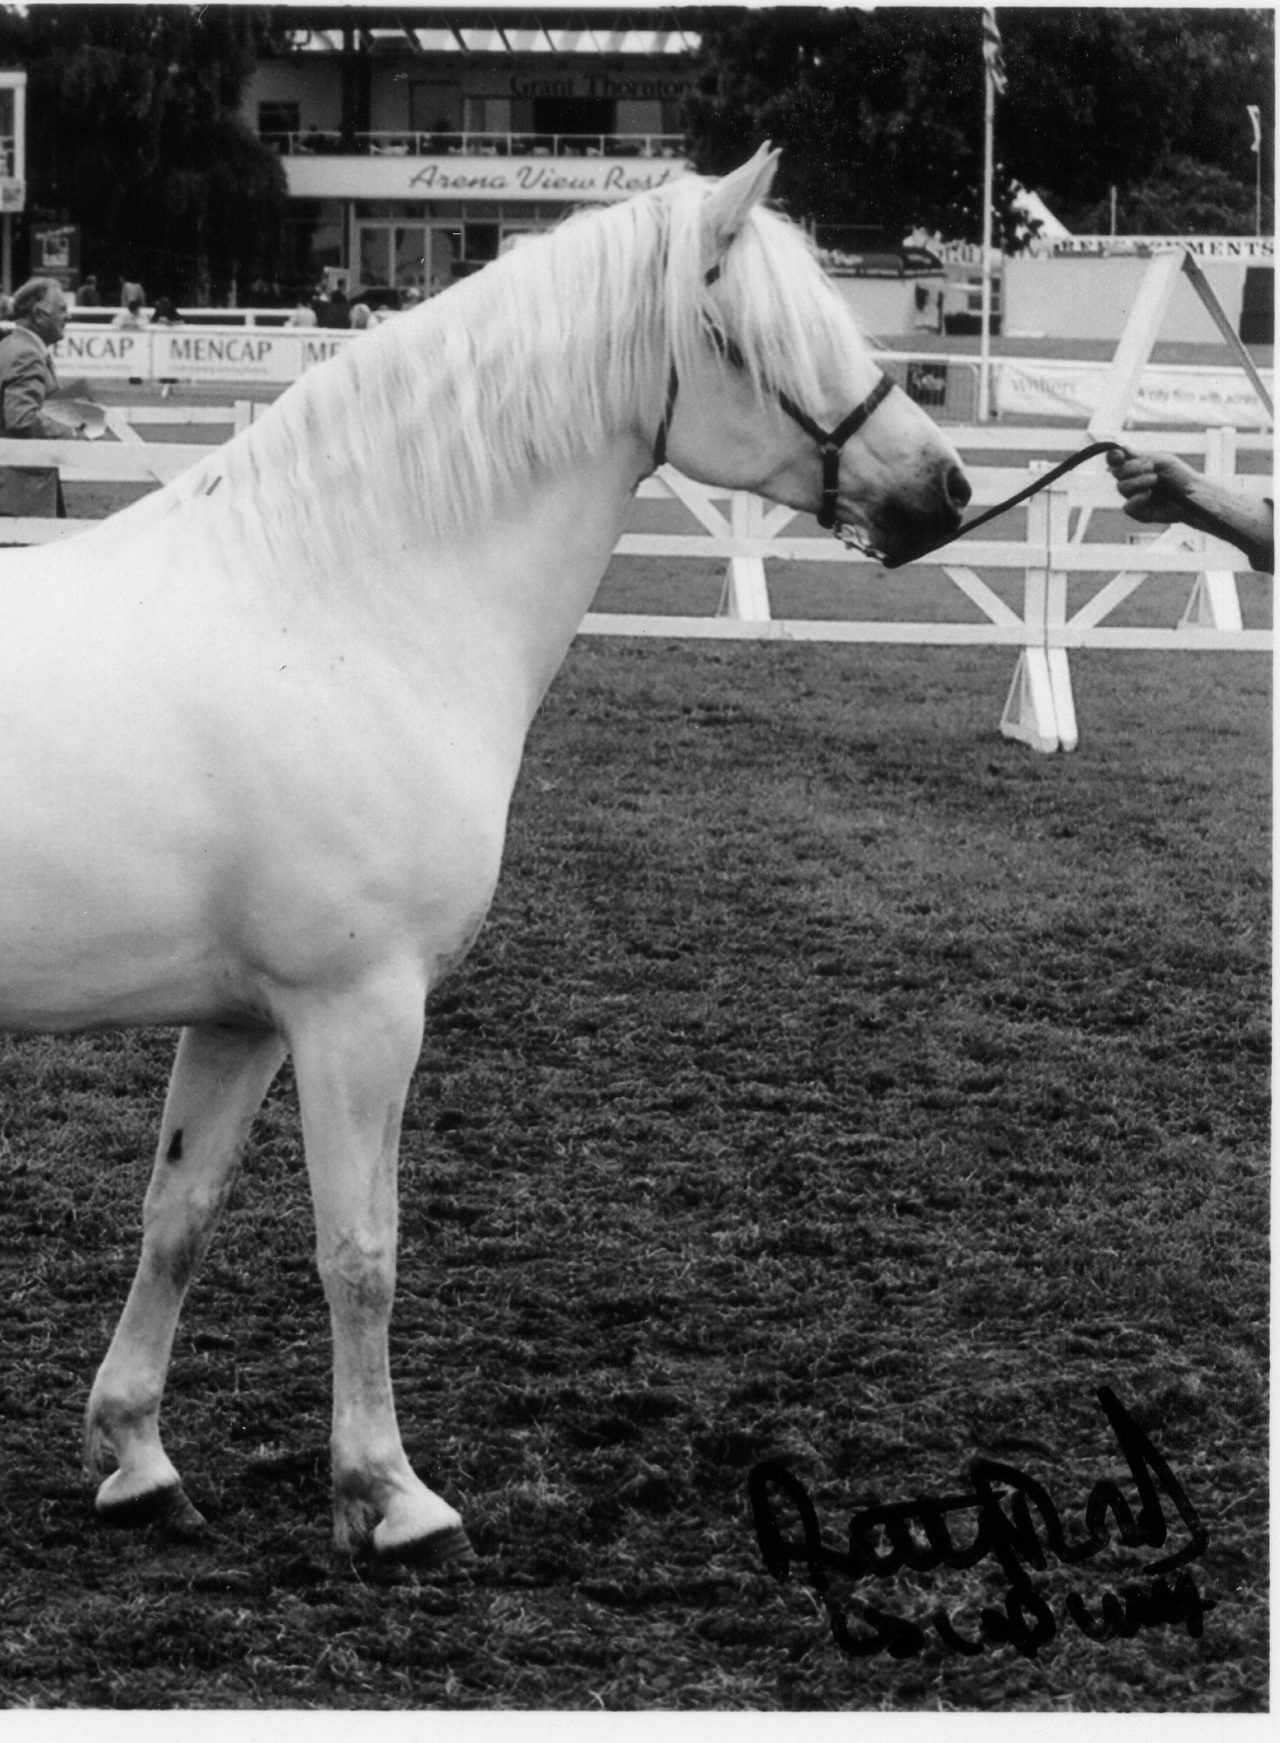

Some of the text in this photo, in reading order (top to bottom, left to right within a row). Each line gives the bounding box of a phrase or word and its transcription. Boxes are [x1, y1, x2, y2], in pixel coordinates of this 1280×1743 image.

[509, 75, 573, 97] Grant
[409, 164, 506, 189] Arena
[517, 165, 595, 189] View
[53, 336, 134, 359] ENCAP
[170, 337, 272, 362] MENCAP
